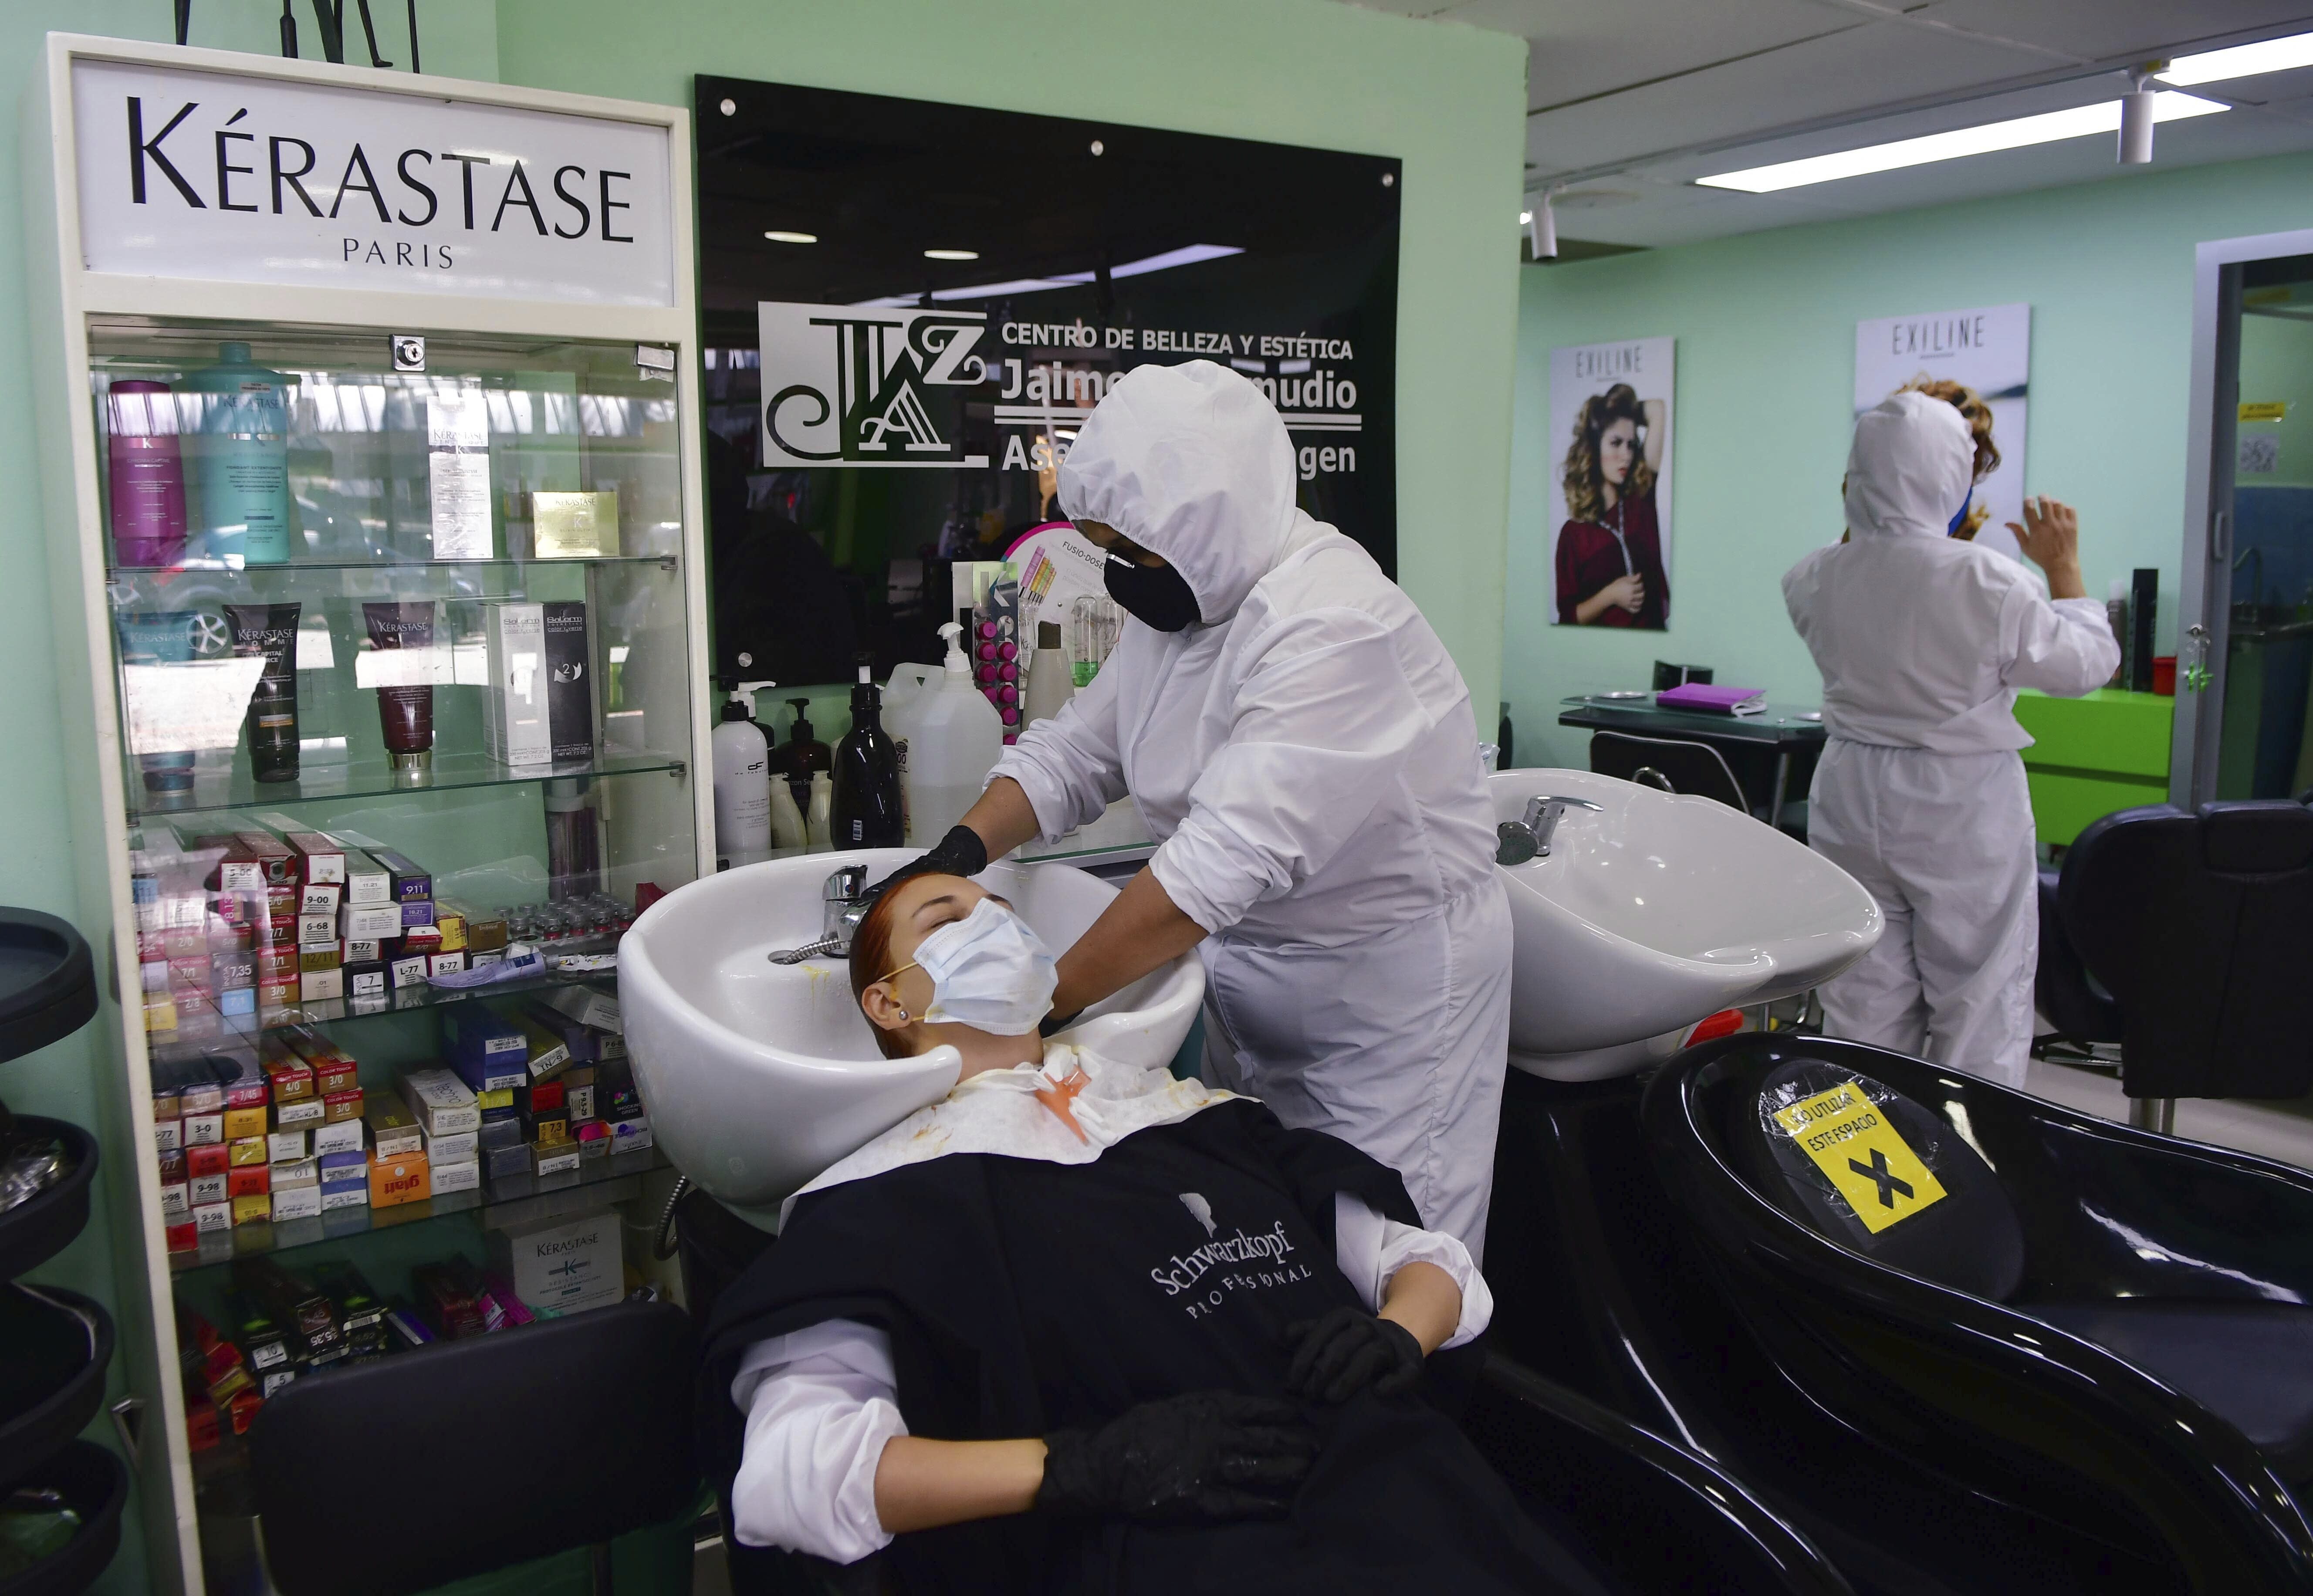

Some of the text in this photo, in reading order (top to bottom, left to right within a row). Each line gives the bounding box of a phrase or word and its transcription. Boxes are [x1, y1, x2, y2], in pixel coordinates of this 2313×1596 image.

[127, 96, 633, 243] KÉRASTASE
[343, 238, 453, 269] PARIS
[1893, 315, 1985, 355] EXILINE
[1002, 322, 1353, 360] CENTRO DE BELLEZA Y ESTÉTICA
[1576, 345, 1642, 379] EXILINE
[1249, 370, 1357, 409] mudio
[1299, 446, 1356, 480] gen
[1062, 541, 1105, 569] FUSIO-DOSE
[238, 629, 293, 641] KÉRASTASE
[562, 663, 570, 674] 2
[306, 922, 328, 930] 6-68
[305, 953, 334, 963] 12/11
[400, 965, 419, 975] L-77
[439, 961, 457, 970] 8-77
[368, 976, 374, 985] 7
[271, 986, 286, 996] 3/0
[329, 1075, 343, 1085] 3/0
[285, 1082, 300, 1092] 4/0
[336, 1103, 350, 1113] 3/0
[156, 1130, 173, 1138] -77
[195, 1125, 211, 1133] 3-0
[1807, 1114, 1877, 1152] ESTE ESPACIO
[197, 1183, 220, 1193] 9-98
[383, 1174, 420, 1195] glatt
[537, 1233, 599, 1257] KÉRASTASE
[1151, 1221, 1295, 1295] Schwarzkopf
